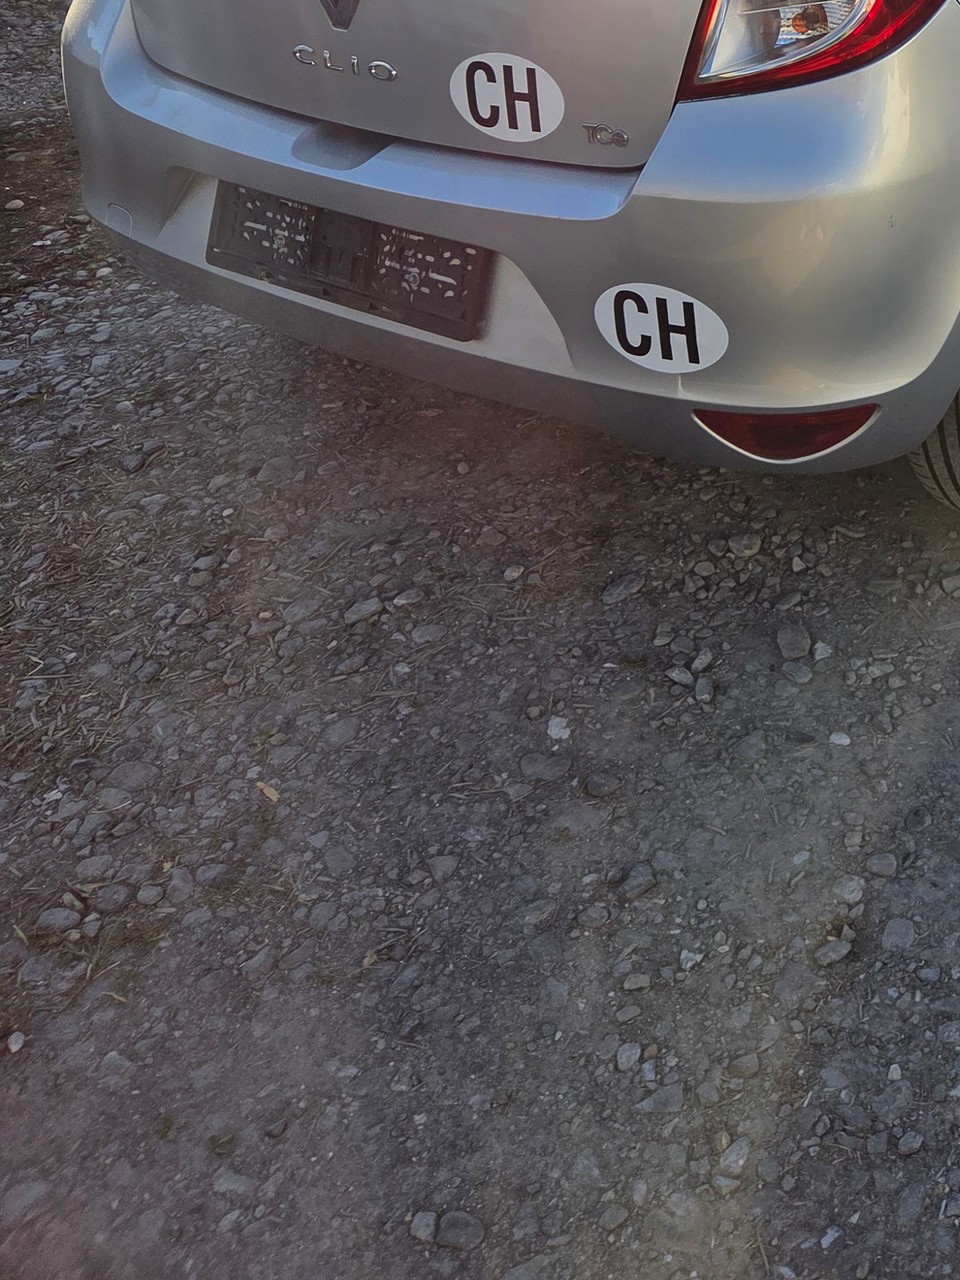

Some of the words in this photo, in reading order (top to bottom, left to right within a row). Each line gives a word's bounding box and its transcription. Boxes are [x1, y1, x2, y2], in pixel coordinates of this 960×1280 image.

[292, 44, 397, 81] CLIO
[466, 61, 542, 132] CH
[582, 122, 630, 147] TCe
[613, 290, 700, 365] CH
